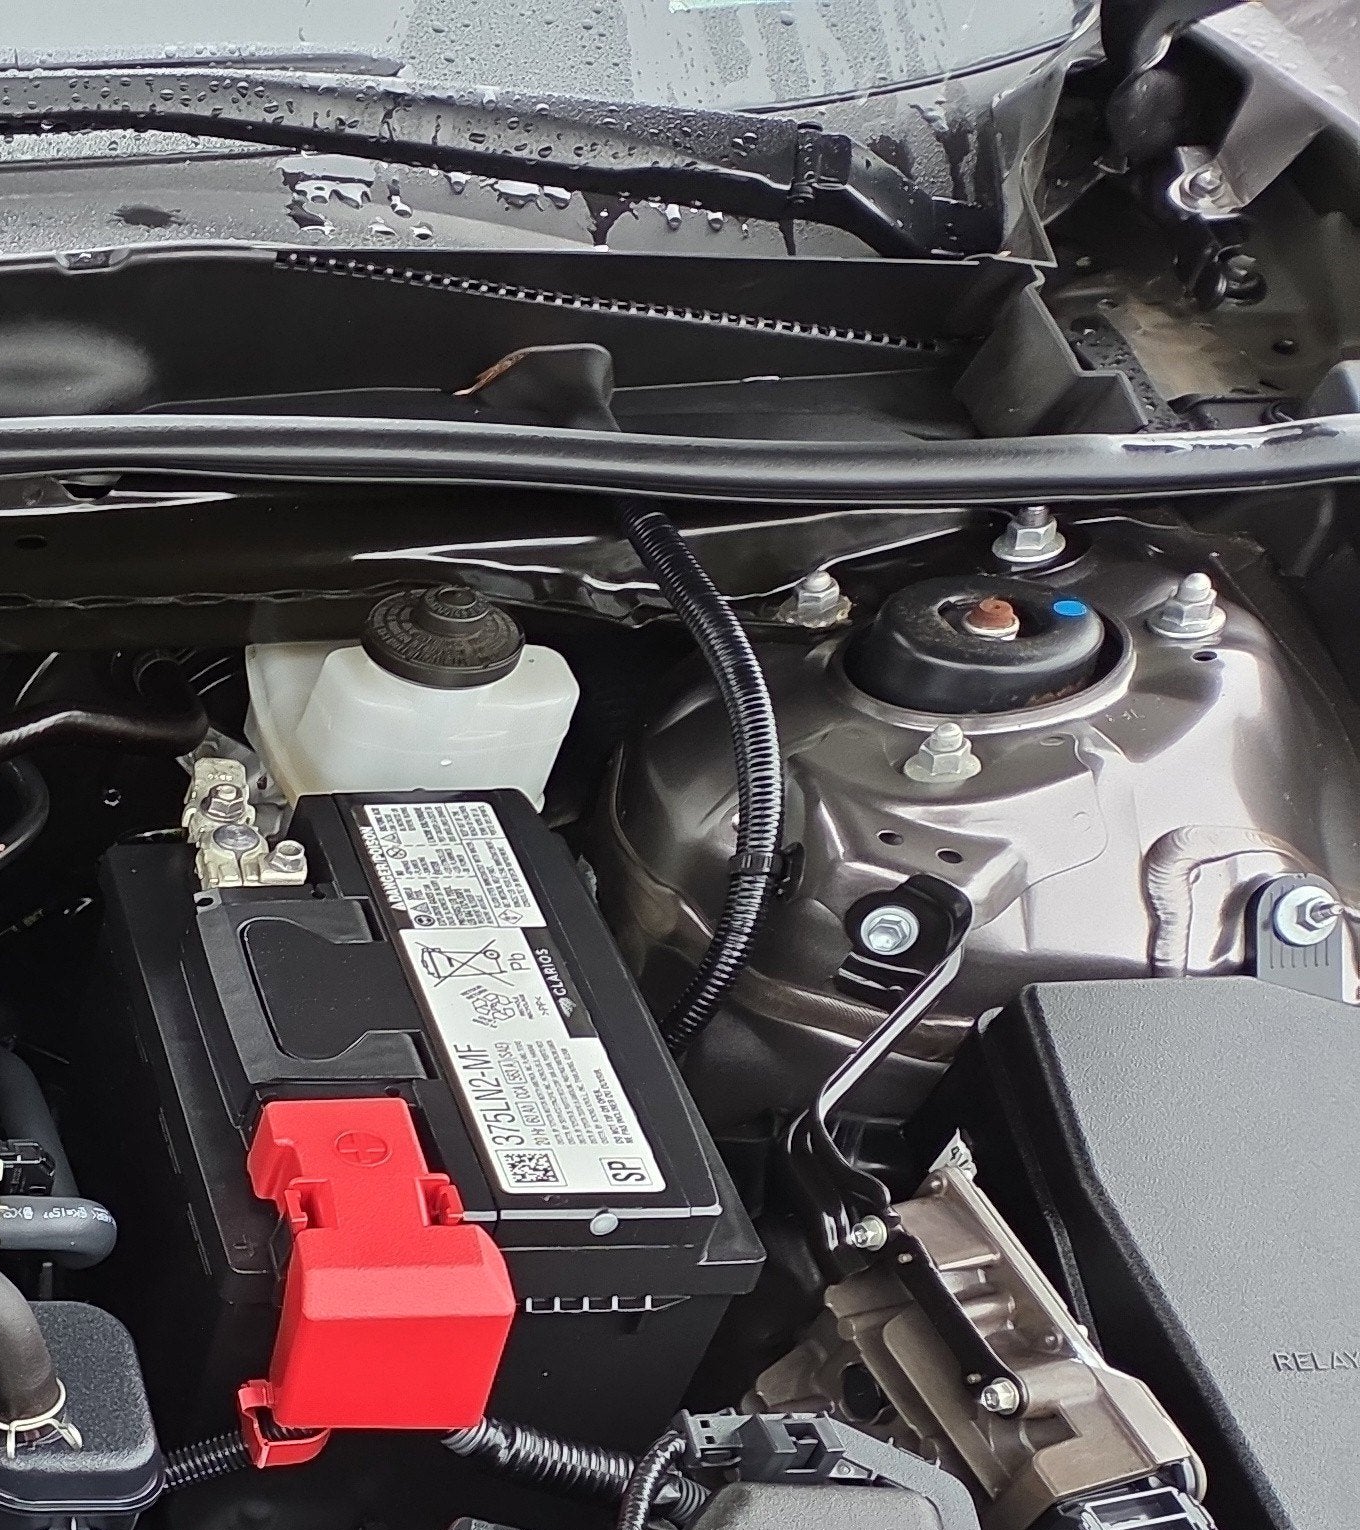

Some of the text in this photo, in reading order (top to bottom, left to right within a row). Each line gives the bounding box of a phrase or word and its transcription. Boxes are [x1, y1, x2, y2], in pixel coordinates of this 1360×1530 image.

[510, 952, 531, 971] Pb
[535, 948, 567, 996] CLARIOS
[453, 1043, 525, 1146] 375LN2-MF
[606, 1160, 647, 1182] SP
[1272, 1350, 1360, 1373] RELAY
